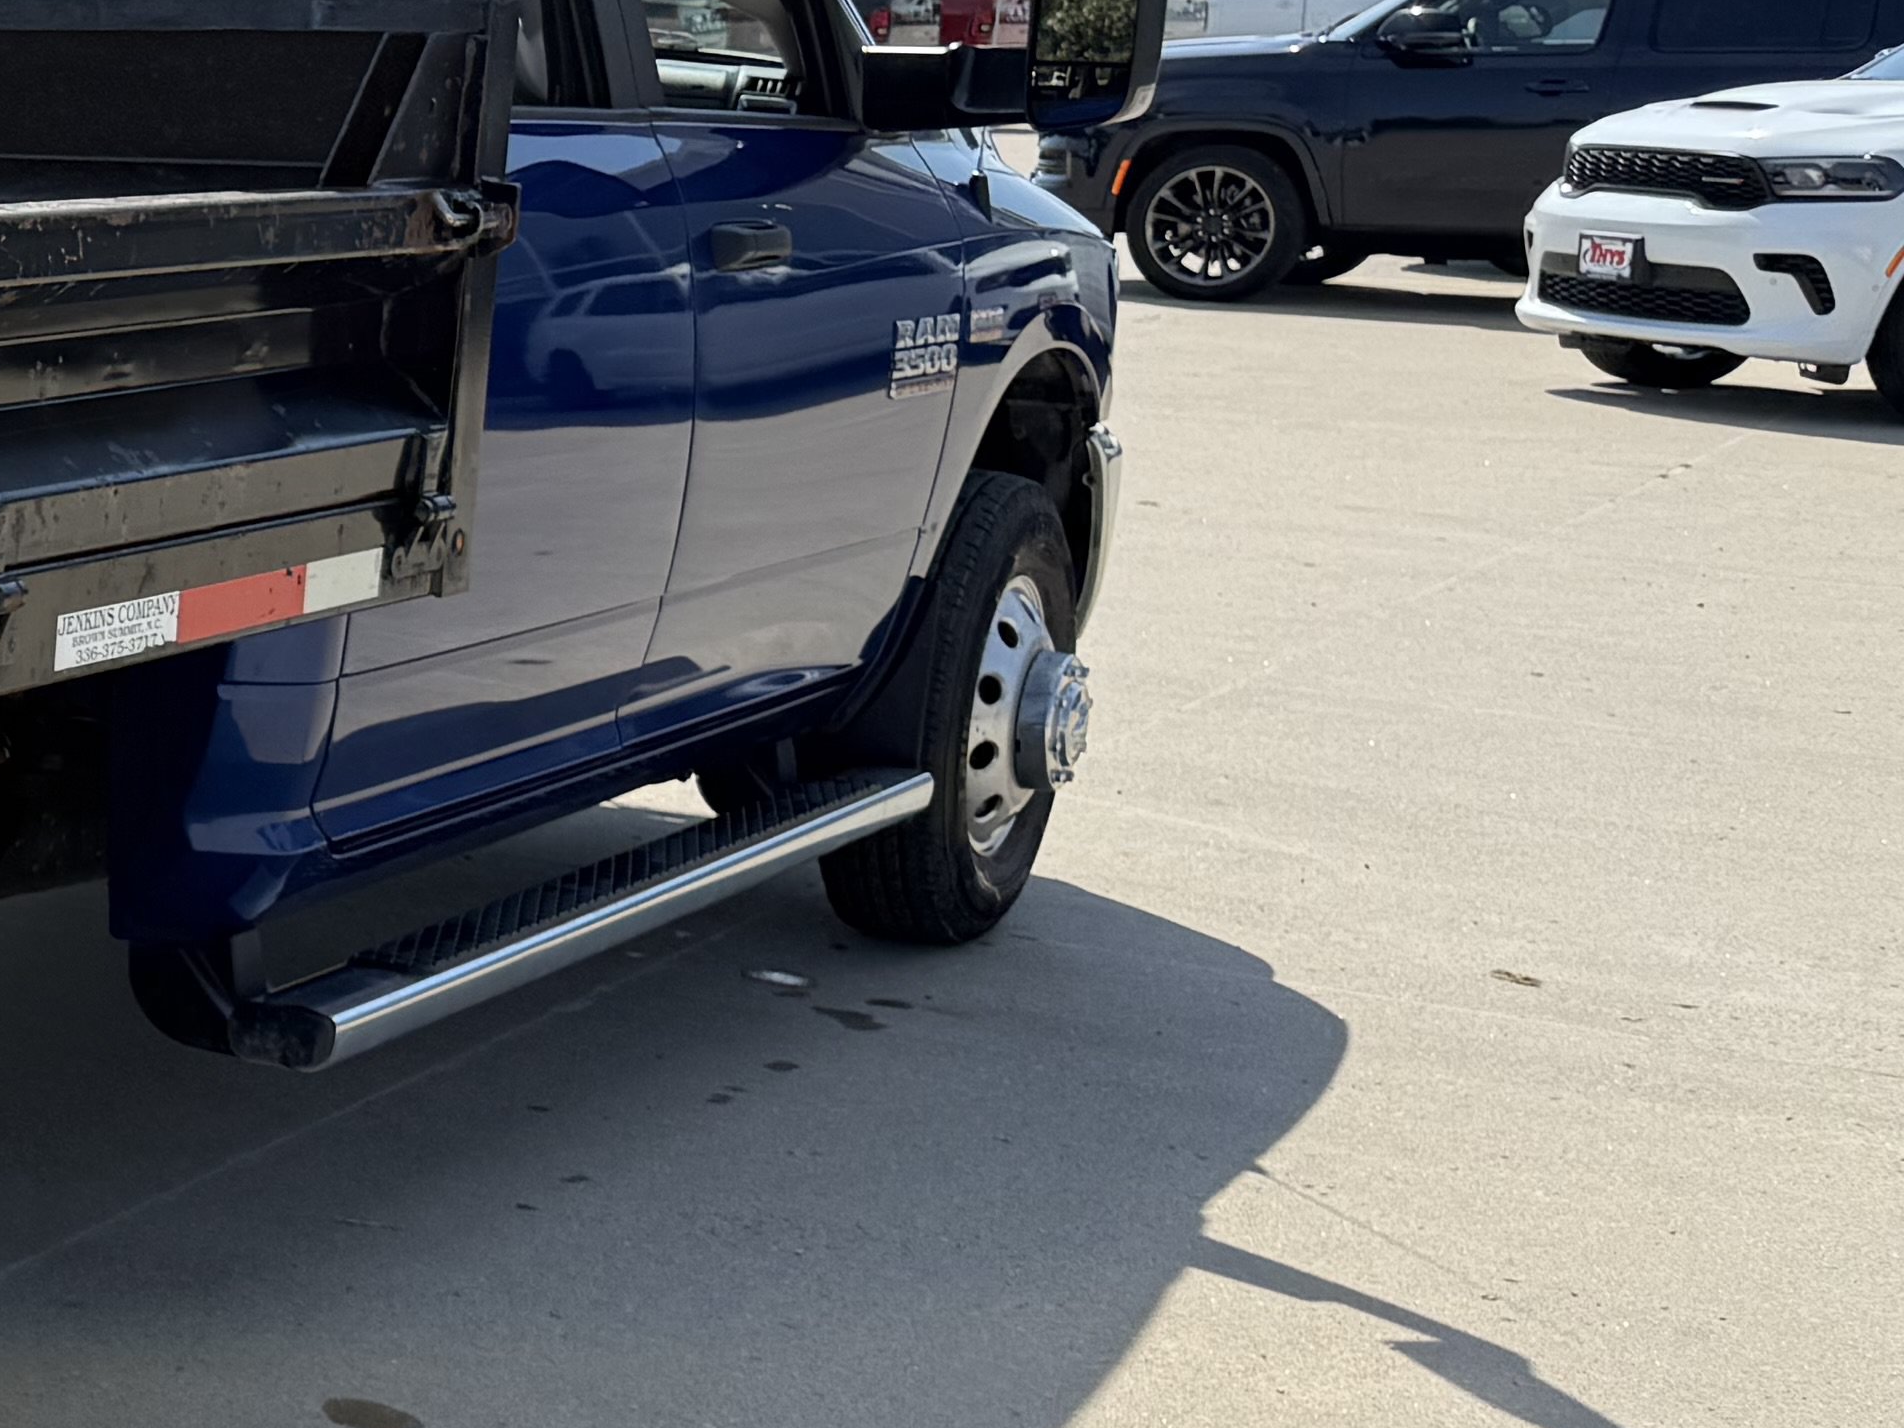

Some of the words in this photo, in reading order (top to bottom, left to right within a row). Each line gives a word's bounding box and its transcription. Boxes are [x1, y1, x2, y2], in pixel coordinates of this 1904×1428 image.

[895, 313, 961, 350] RAM
[892, 343, 959, 380] 3500
[58, 607, 114, 636] JENKINS
[118, 594, 177, 624] COMPANY
[72, 631, 106, 648] BROWN
